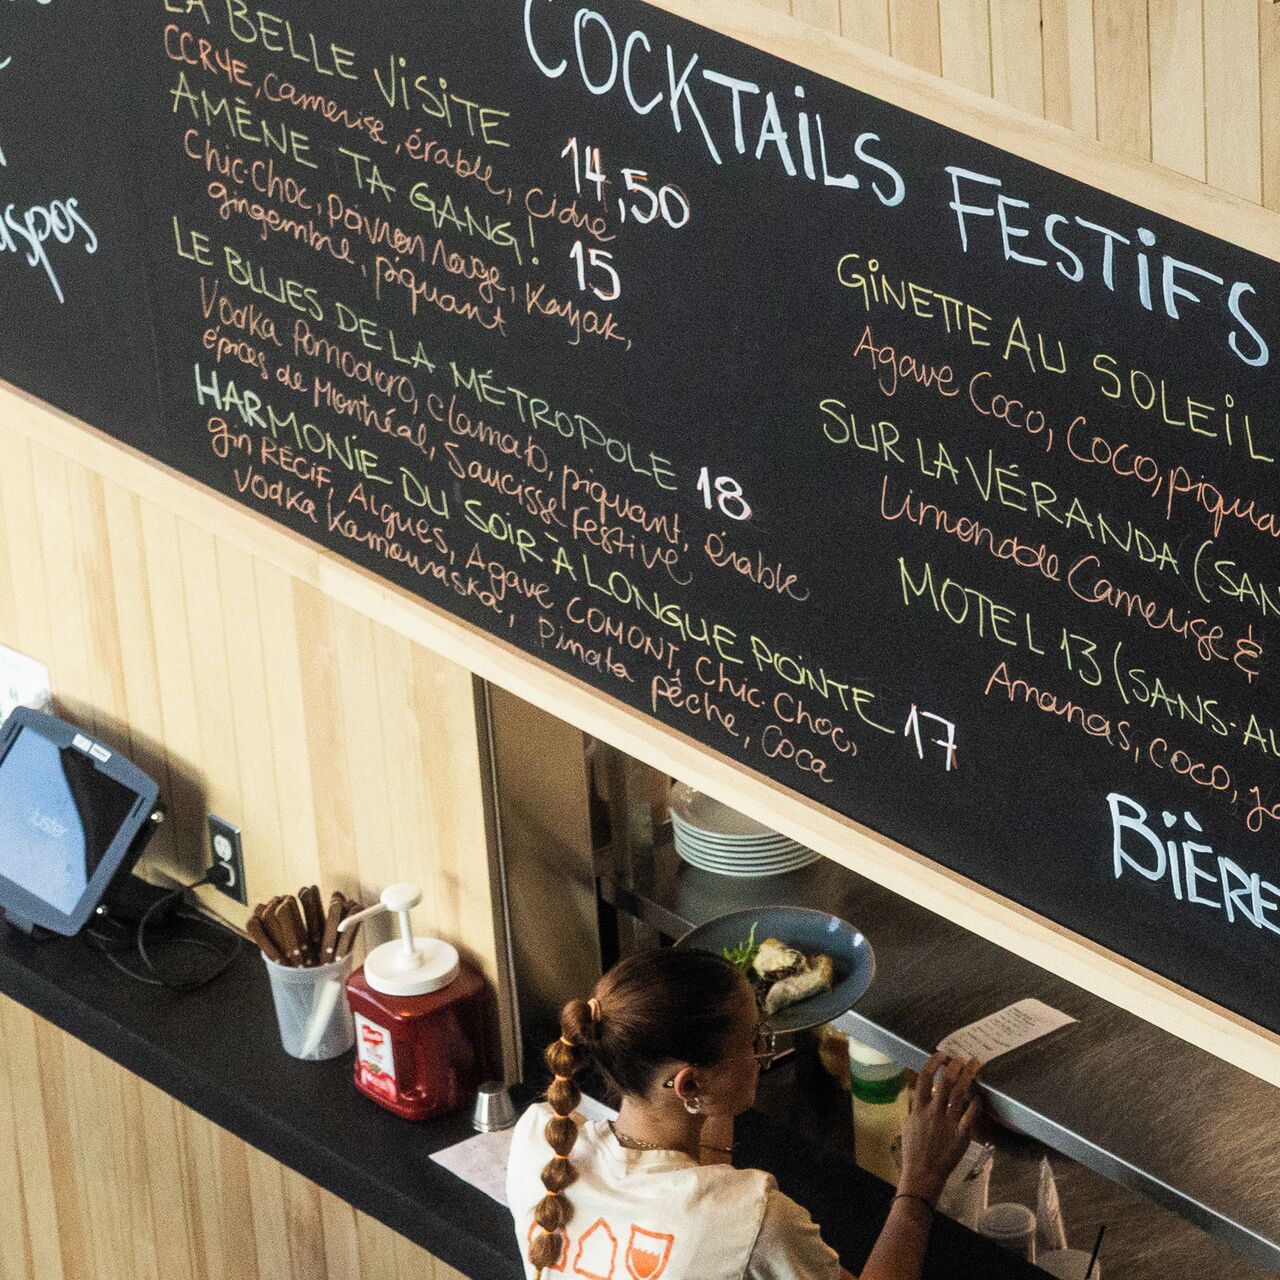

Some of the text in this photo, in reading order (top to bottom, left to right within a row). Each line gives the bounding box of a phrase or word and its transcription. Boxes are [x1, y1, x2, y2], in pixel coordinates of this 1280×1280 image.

[226, 0, 358, 80] BELLE
[338, 147, 396, 202] TA
[569, 240, 622, 301] 15
[561, 136, 691, 229] 14,50
[172, 215, 751, 521] LE BLUES DE LA MÉTROPOLE 18
[276, 366, 308, 392] de
[854, 325, 959, 396] Agave
[1003, 317, 1066, 373] AU
[819, 399, 904, 463] SUR
[917, 438, 959, 485] LA
[965, 449, 1180, 574] VÉRANDA
[400, 467, 450, 519] DU
[582, 554, 744, 664] LONGUE
[904, 703, 957, 771] 17
[898, 556, 1045, 656] MOTEL
[1060, 627, 1102, 686] 13
